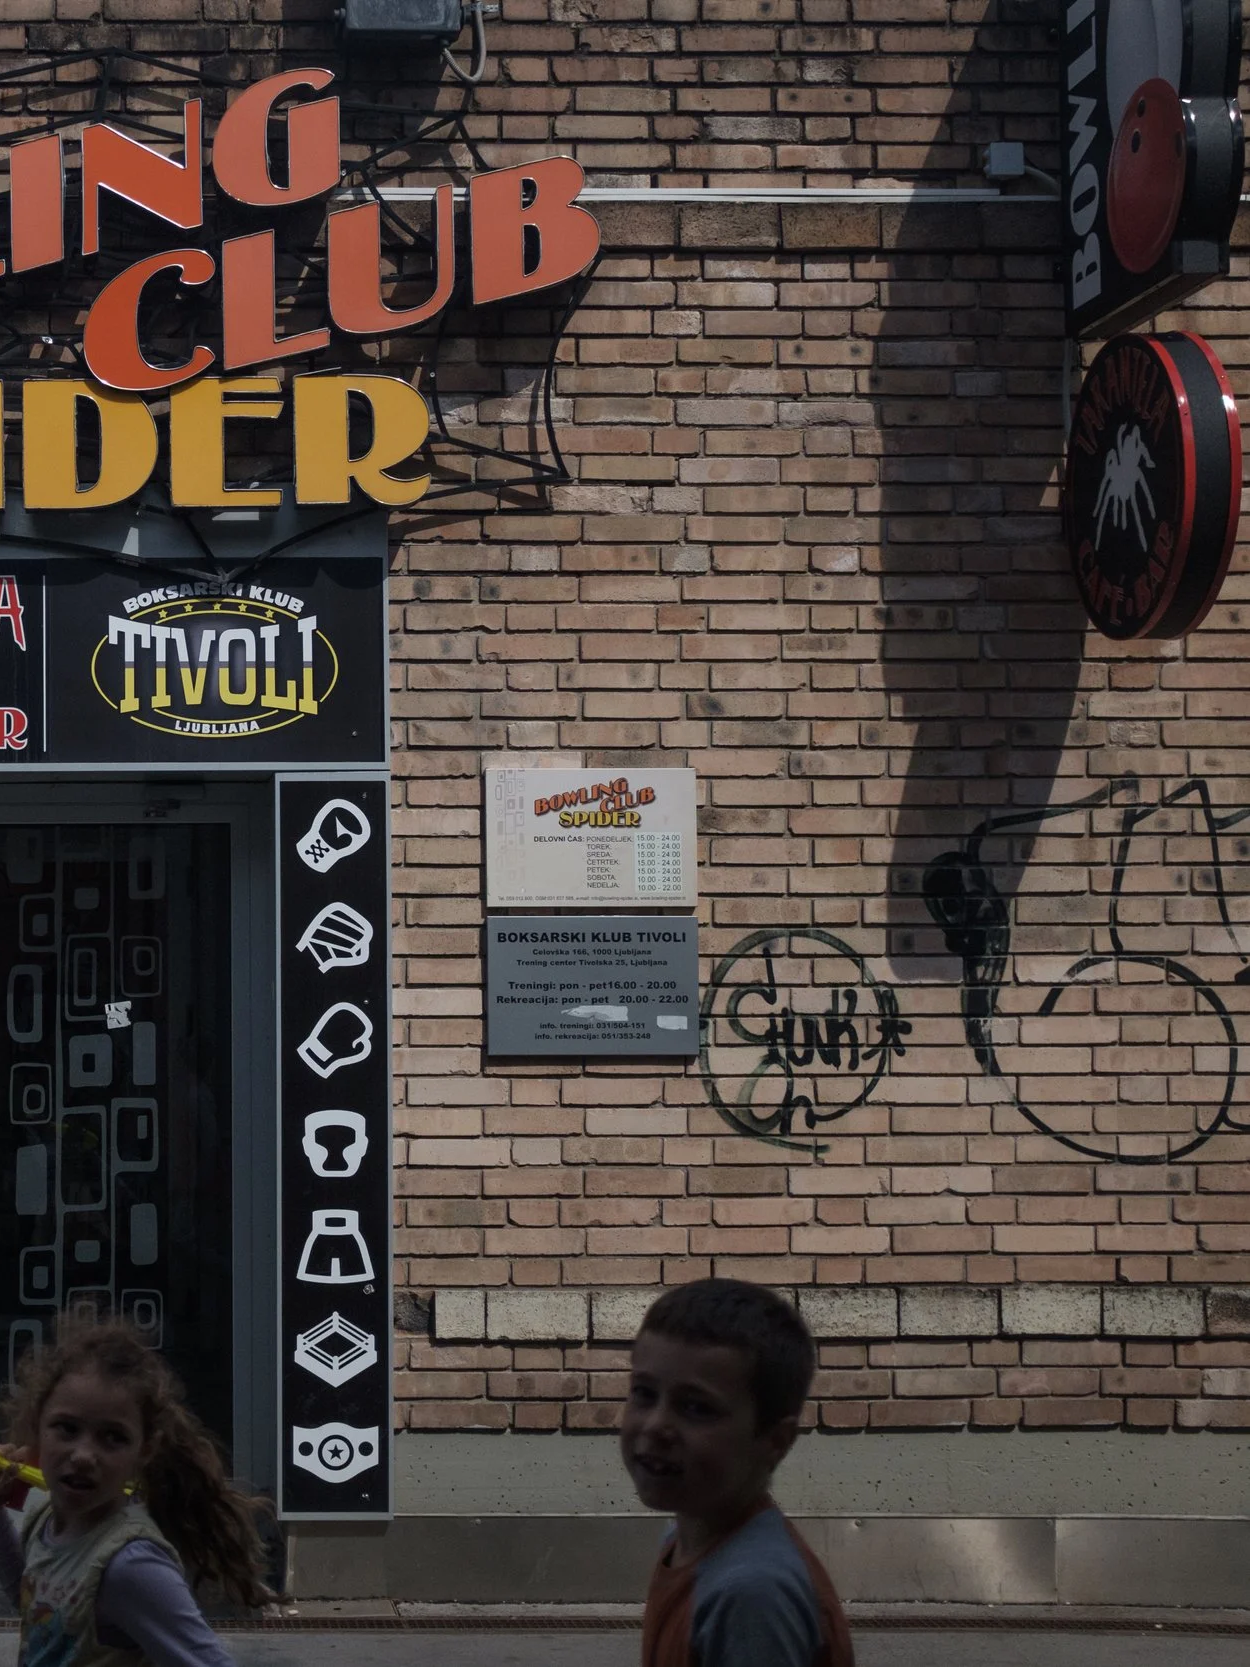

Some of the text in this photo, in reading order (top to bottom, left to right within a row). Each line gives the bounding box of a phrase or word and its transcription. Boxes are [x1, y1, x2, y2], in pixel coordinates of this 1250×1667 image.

[84, 154, 601, 391] CLUB
[121, 581, 305, 615] BOKSARSKI KLUB
[107, 614, 319, 716] TIVOLI
[174, 719, 261, 735] LJUBLJANA
[534, 777, 629, 817] BOWLING
[600, 786, 656, 813] CLUB
[559, 810, 642, 828] SPIDER
[533, 835, 566, 843] DELOVNI
[567, 834, 585, 843] ČAS:
[637, 834, 656, 842] 15.00
[661, 834, 681, 842] 24.00
[637, 842, 657, 850] 15.00
[661, 842, 682, 850] 24.00
[637, 859, 657, 867] 15.00
[661, 859, 682, 867] 24.00
[637, 867, 657, 875] 15.00
[661, 867, 682, 875] 24.00
[637, 875, 657, 883] 10.00
[661, 875, 682, 883] 24.00
[637, 884, 657, 892] 10.00
[661, 884, 682, 892] 22.00
[497, 932, 686, 943] BOKSARSKI KLUB TIVOLI
[614, 949, 652, 957] Ljubljana
[516, 959, 548, 968] Trening
[615, 959, 629, 968] 25,
[630, 959, 668, 968] Ljubljana
[508, 981, 556, 991] Treningi:
[559, 983, 580, 991] pon
[646, 981, 677, 990] 20.00
[496, 995, 559, 1005] Rekreacija:
[561, 997, 582, 1005] pon
[591, 996, 609, 1005] pet
[619, 995, 649, 1004] 20.00
[658, 995, 689, 1004] 22.00
[534, 1032, 553, 1040] info.
[554, 1033, 600, 1041] rekreacija:
